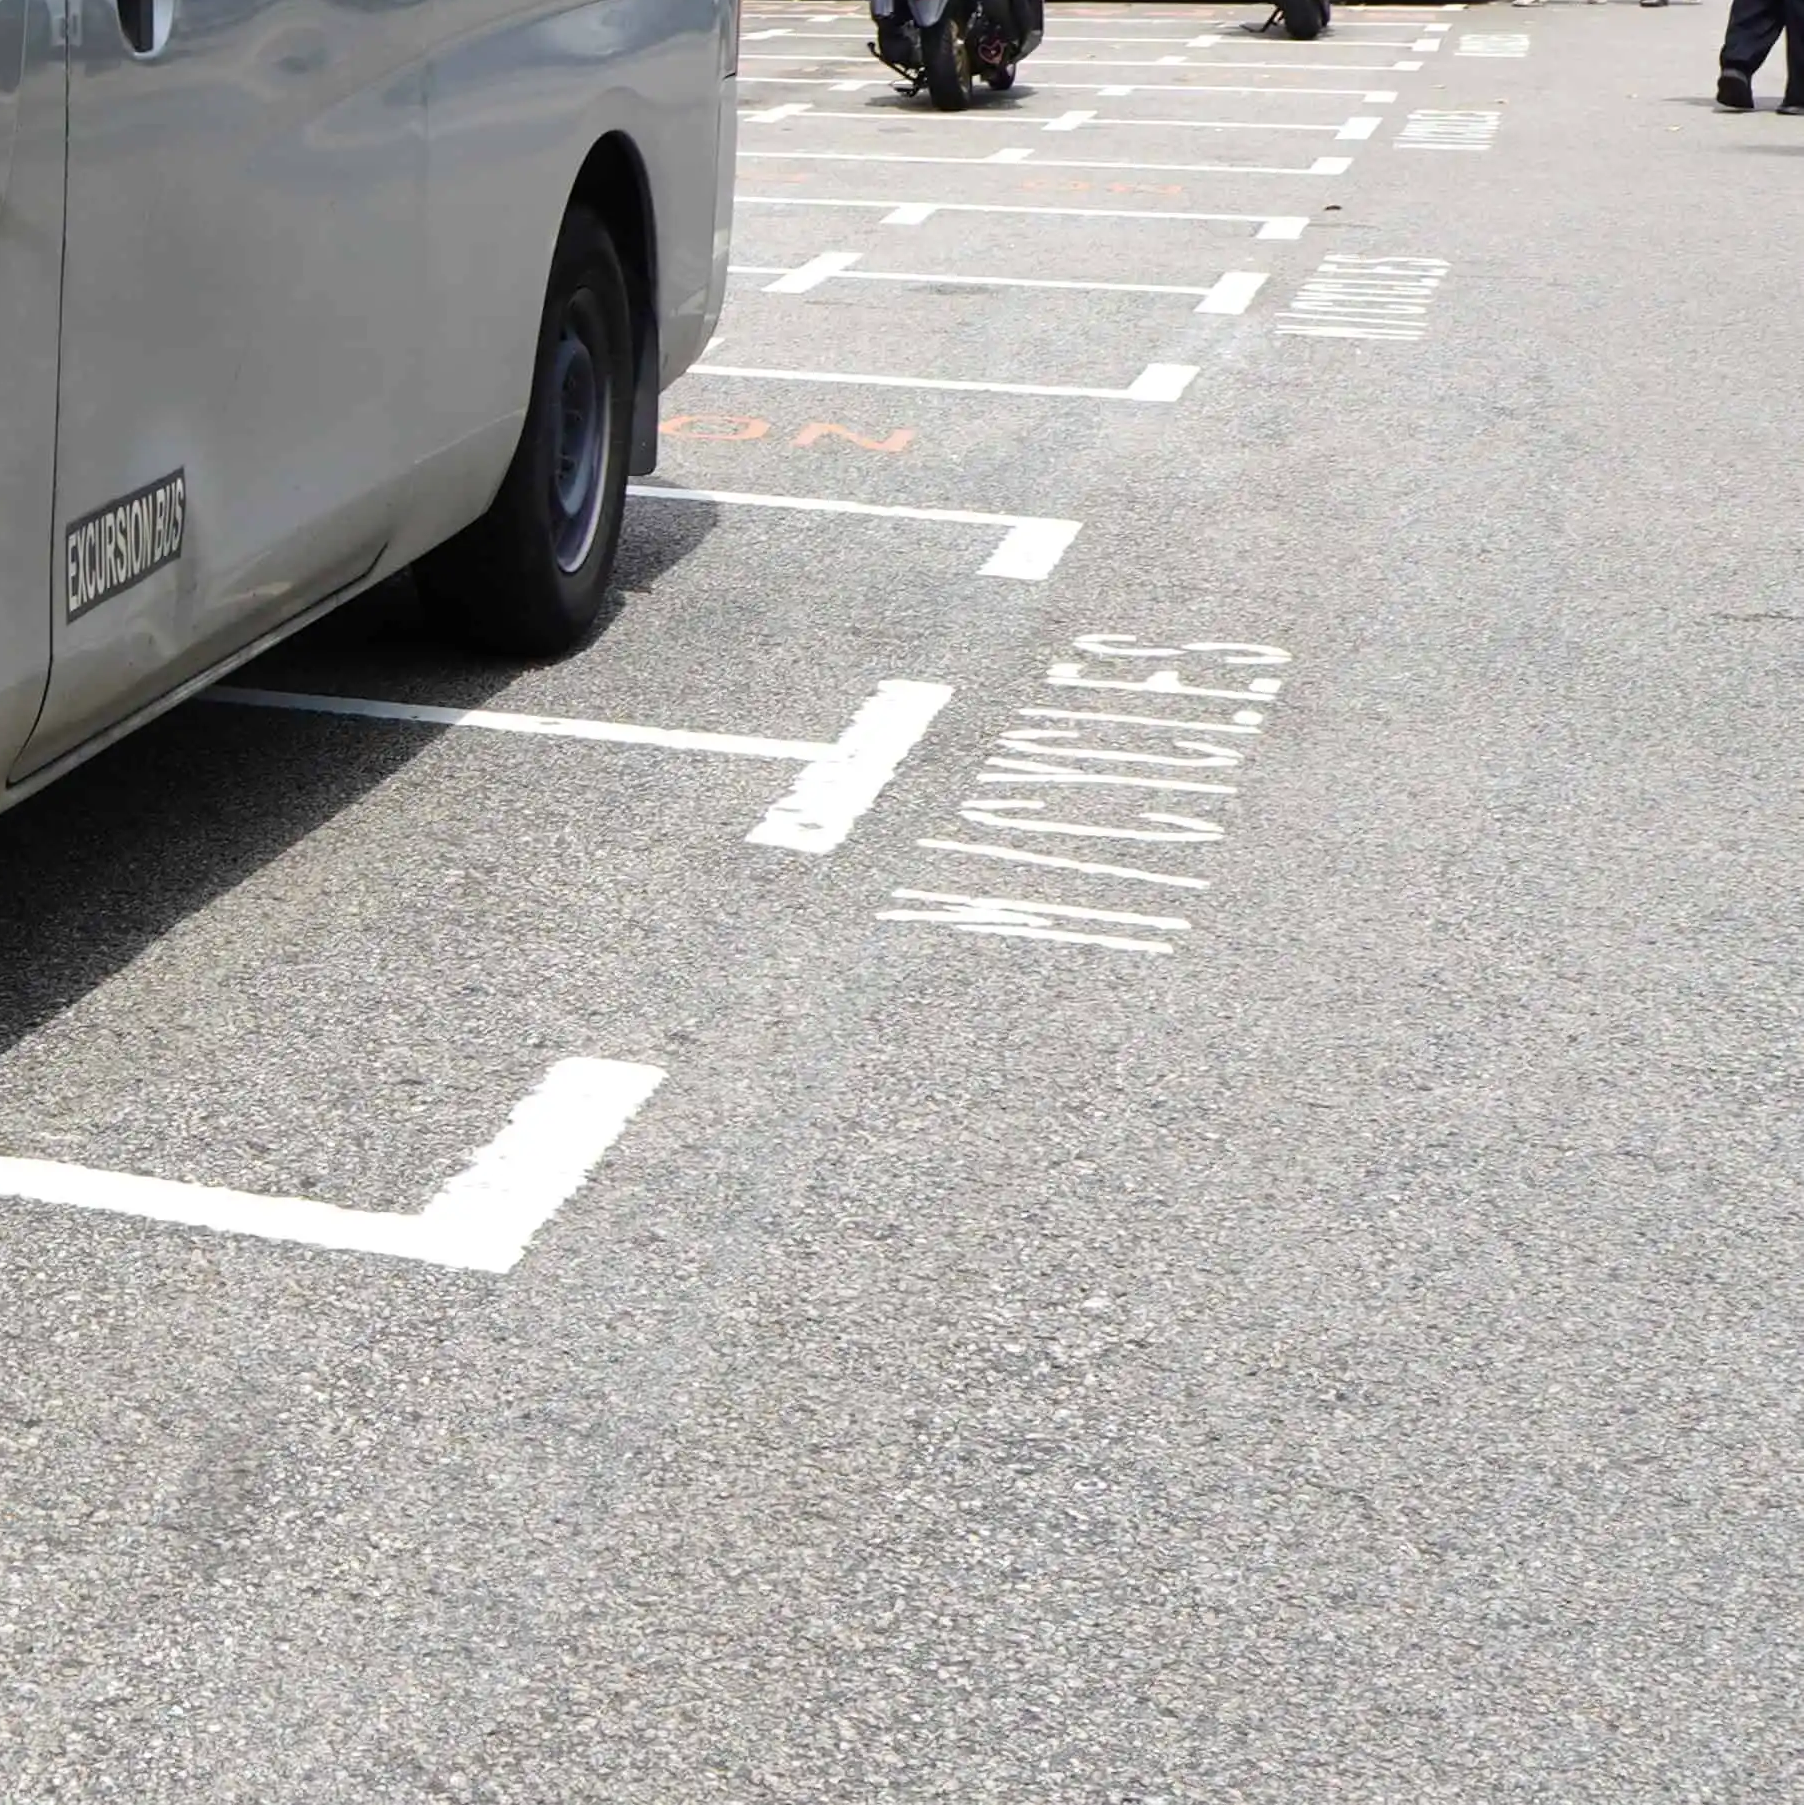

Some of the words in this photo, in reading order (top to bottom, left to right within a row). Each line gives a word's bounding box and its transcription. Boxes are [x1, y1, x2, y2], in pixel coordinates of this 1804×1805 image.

[68, 493, 152, 612] EXCURSION
[153, 477, 184, 563] BUS
[876, 633, 1293, 954] M/CYCLES
